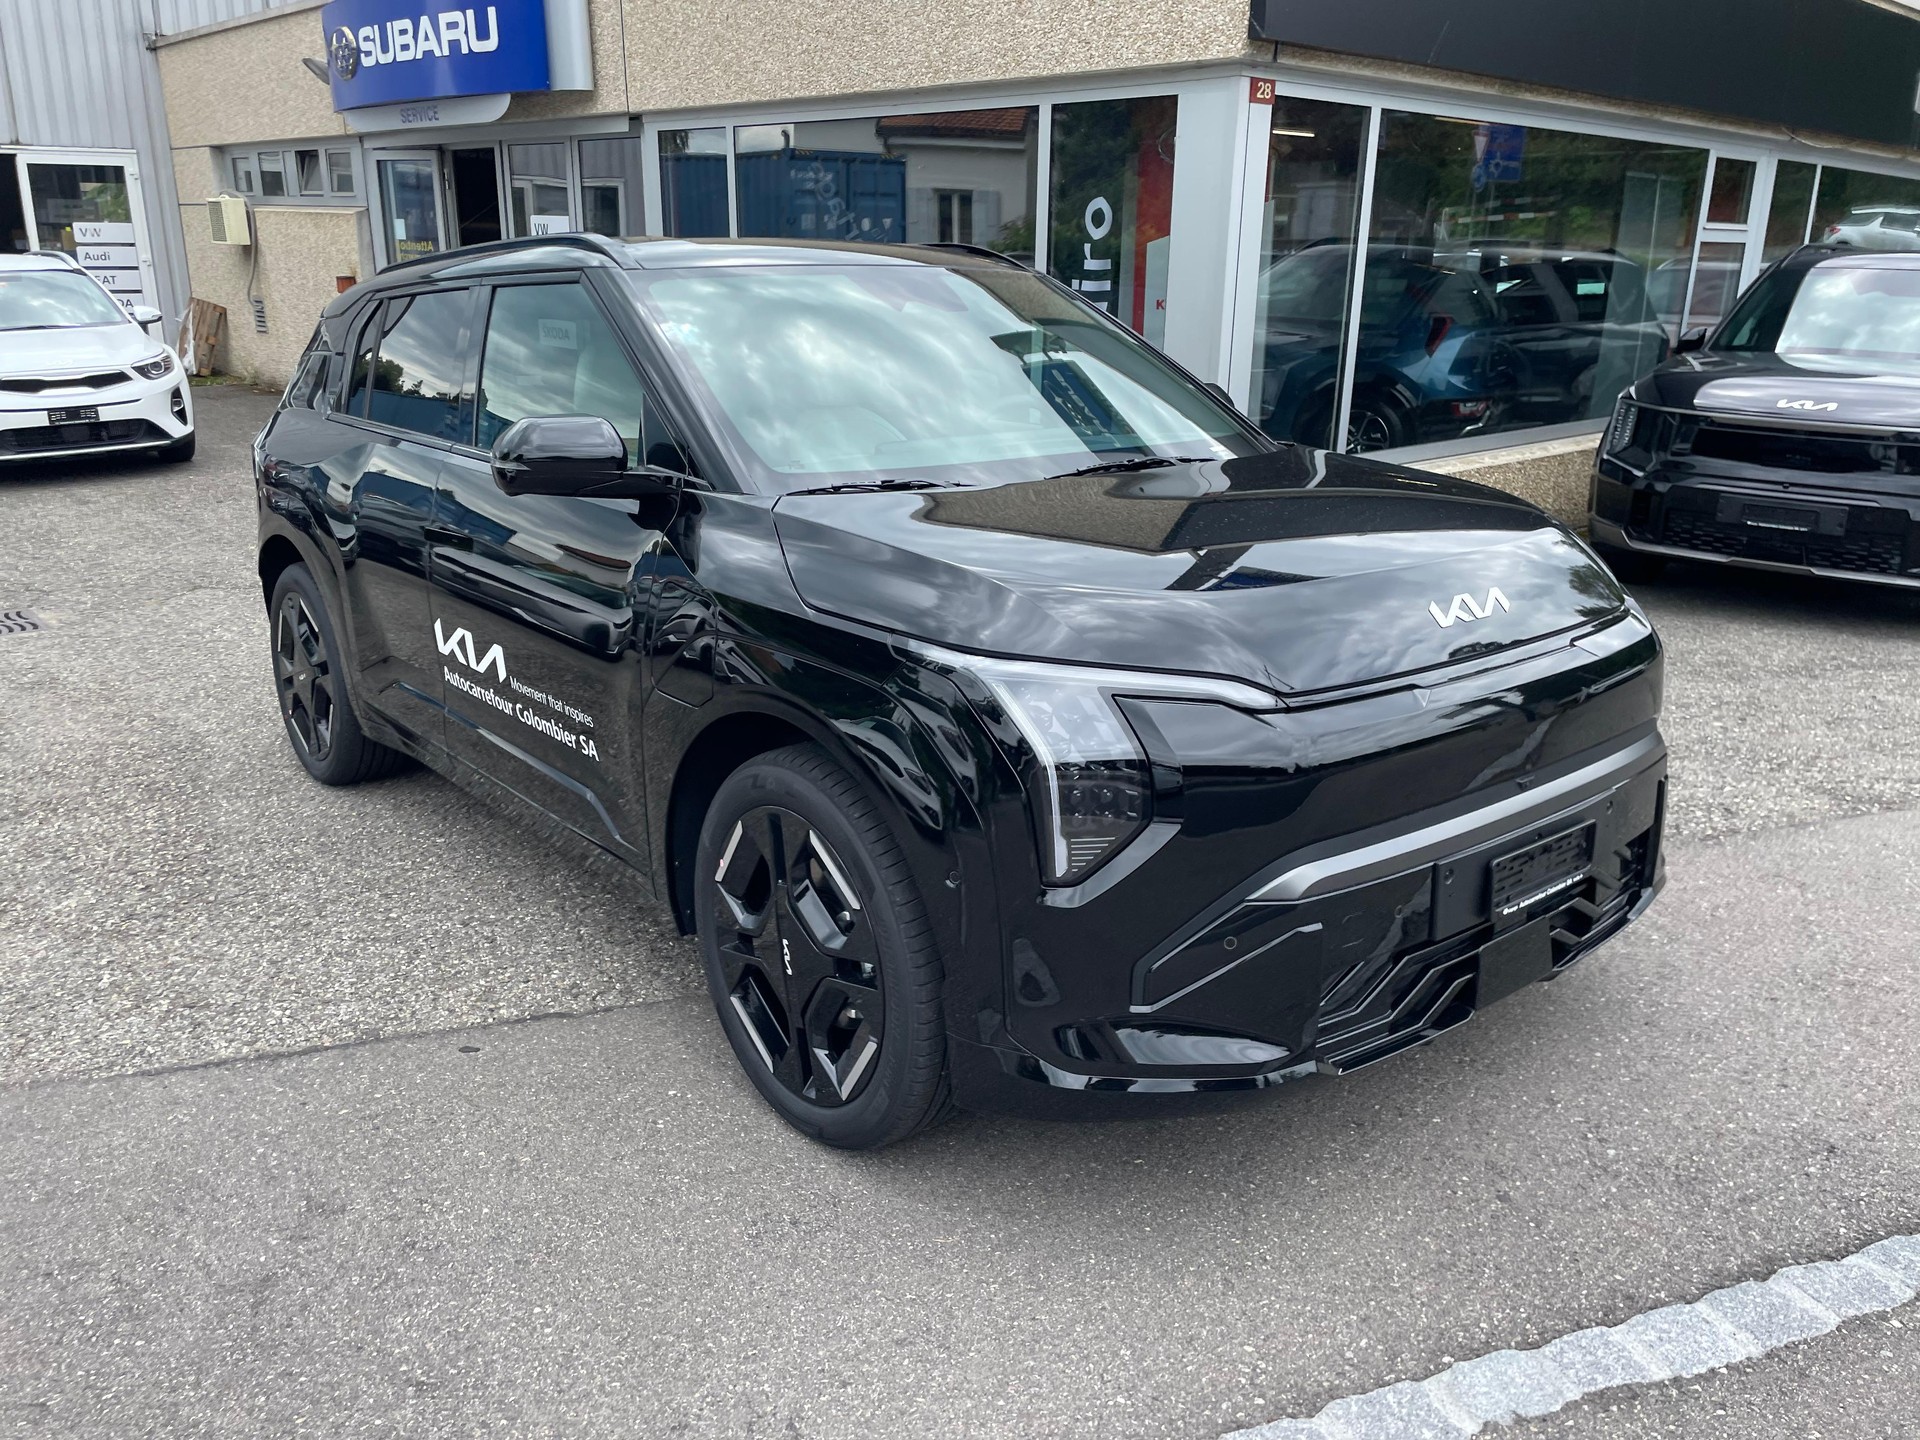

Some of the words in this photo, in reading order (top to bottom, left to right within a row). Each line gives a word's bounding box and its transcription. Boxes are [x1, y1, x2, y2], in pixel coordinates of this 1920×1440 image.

[358, 6, 499, 67] SUBARU
[1256, 81, 1272, 99] 28
[400, 105, 440, 124] SERVICE
[79, 227, 101, 238] VW
[533, 222, 549, 236] VW
[83, 251, 111, 261] Audi
[1071, 196, 1113, 312] iro
[1776, 399, 1838, 412] KIA
[1428, 586, 1511, 628] KIA
[433, 618, 507, 683] KIA
[443, 665, 514, 717] Autocarrefour
[515, 703, 577, 749] Colombier
[579, 734, 600, 762] SA
[509, 675, 547, 706] Movement
[547, 694, 563, 713] that
[564, 701, 594, 728] inspires
[782, 938, 793, 976] KIA
